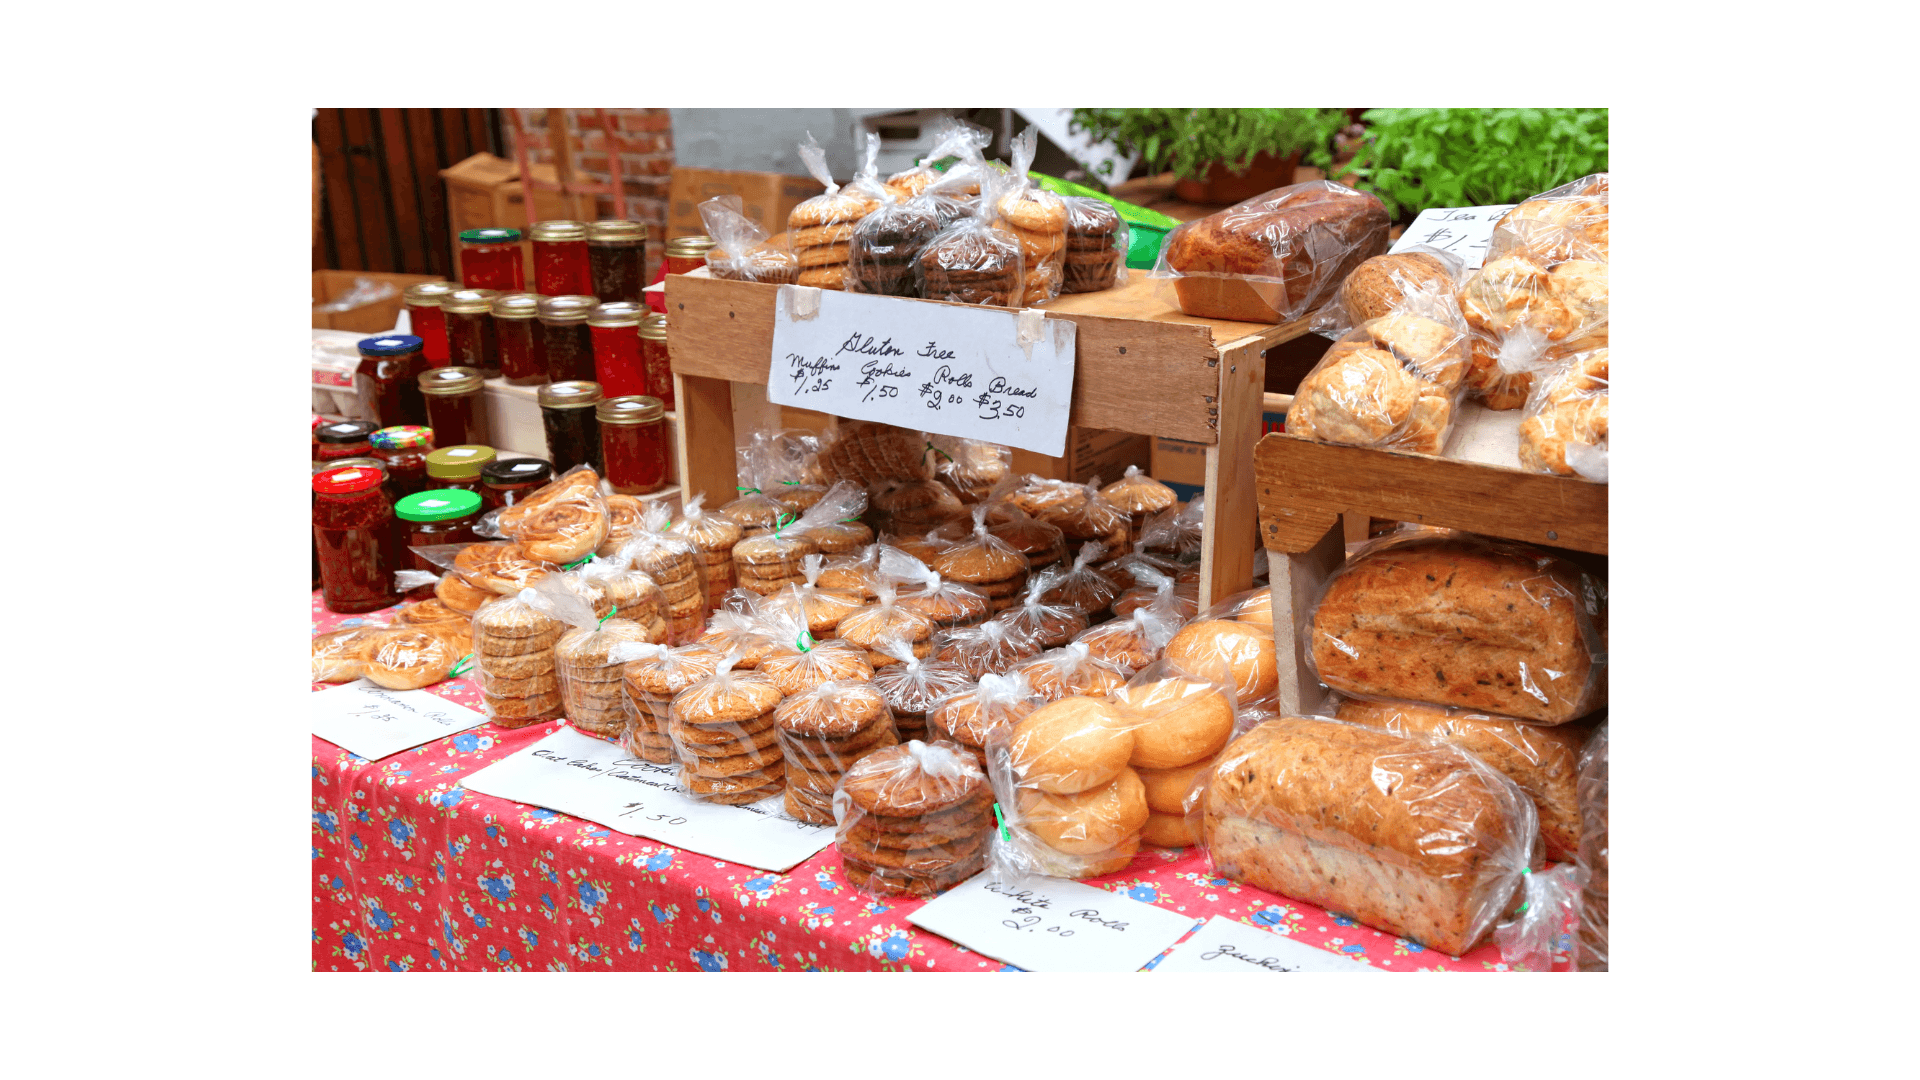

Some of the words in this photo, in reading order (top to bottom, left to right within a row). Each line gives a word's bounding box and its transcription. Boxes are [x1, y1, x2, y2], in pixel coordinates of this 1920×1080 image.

[917, 341, 956, 360] Free
[786, 353, 840, 376] Muffins
[861, 360, 911, 377] Cookies
[934, 365, 972, 387] Rolls
[989, 377, 1037, 398] Bread
[856, 377, 899, 402] $1.50
[973, 392, 1025, 419] $3.50
[619, 802, 687, 825] $1.50
[1070, 909, 1130, 931] Rolls
